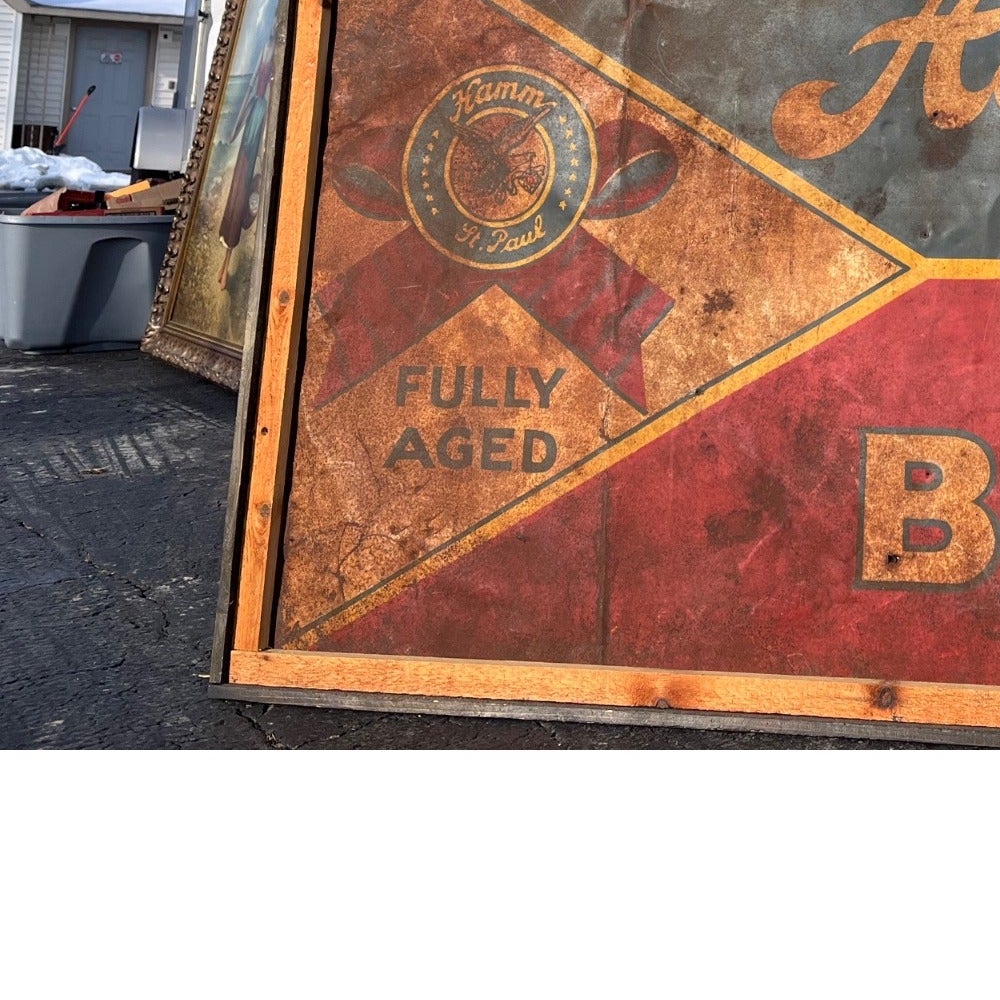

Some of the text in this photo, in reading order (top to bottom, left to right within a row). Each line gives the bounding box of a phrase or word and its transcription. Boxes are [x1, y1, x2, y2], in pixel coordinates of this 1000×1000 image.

[487, 215, 546, 253] Paul
[395, 365, 567, 409] FULLY
[383, 427, 558, 473] AGED
